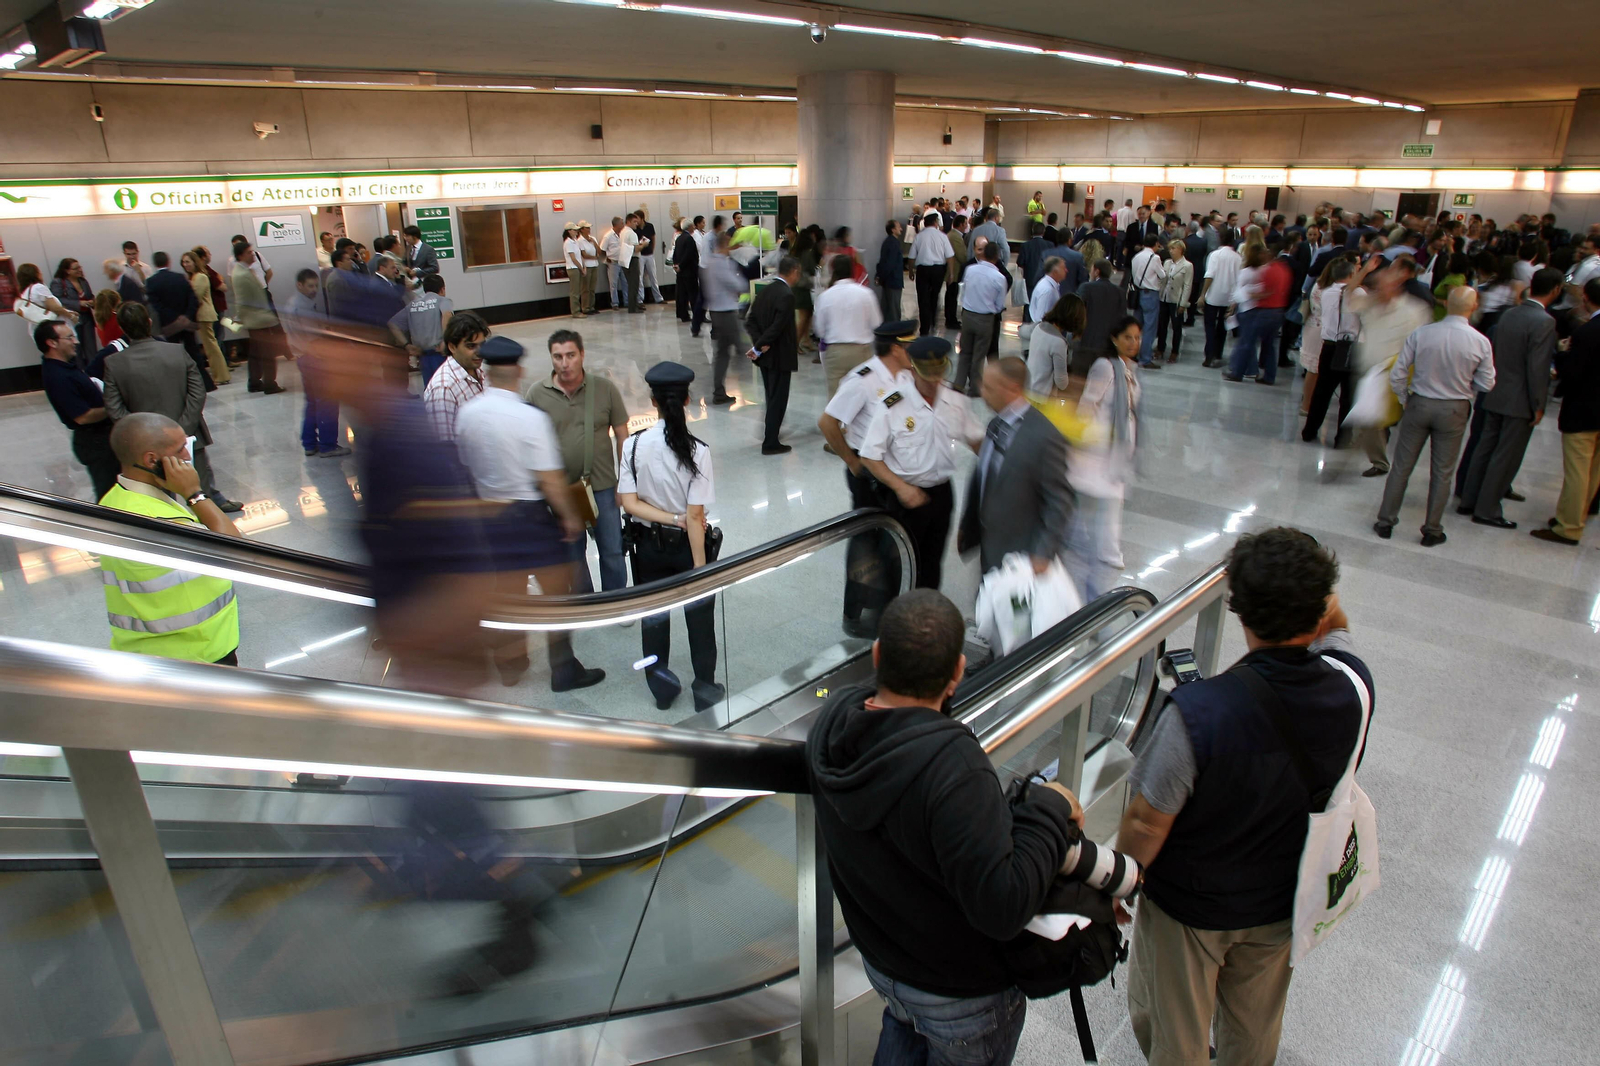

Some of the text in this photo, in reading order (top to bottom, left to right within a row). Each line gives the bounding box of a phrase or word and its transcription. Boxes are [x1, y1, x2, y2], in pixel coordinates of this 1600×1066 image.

[452, 180, 519, 190] Puerta Jerez
[668, 175, 682, 186] de
[150, 183, 424, 206] Oficina de Atencion al Cliente
